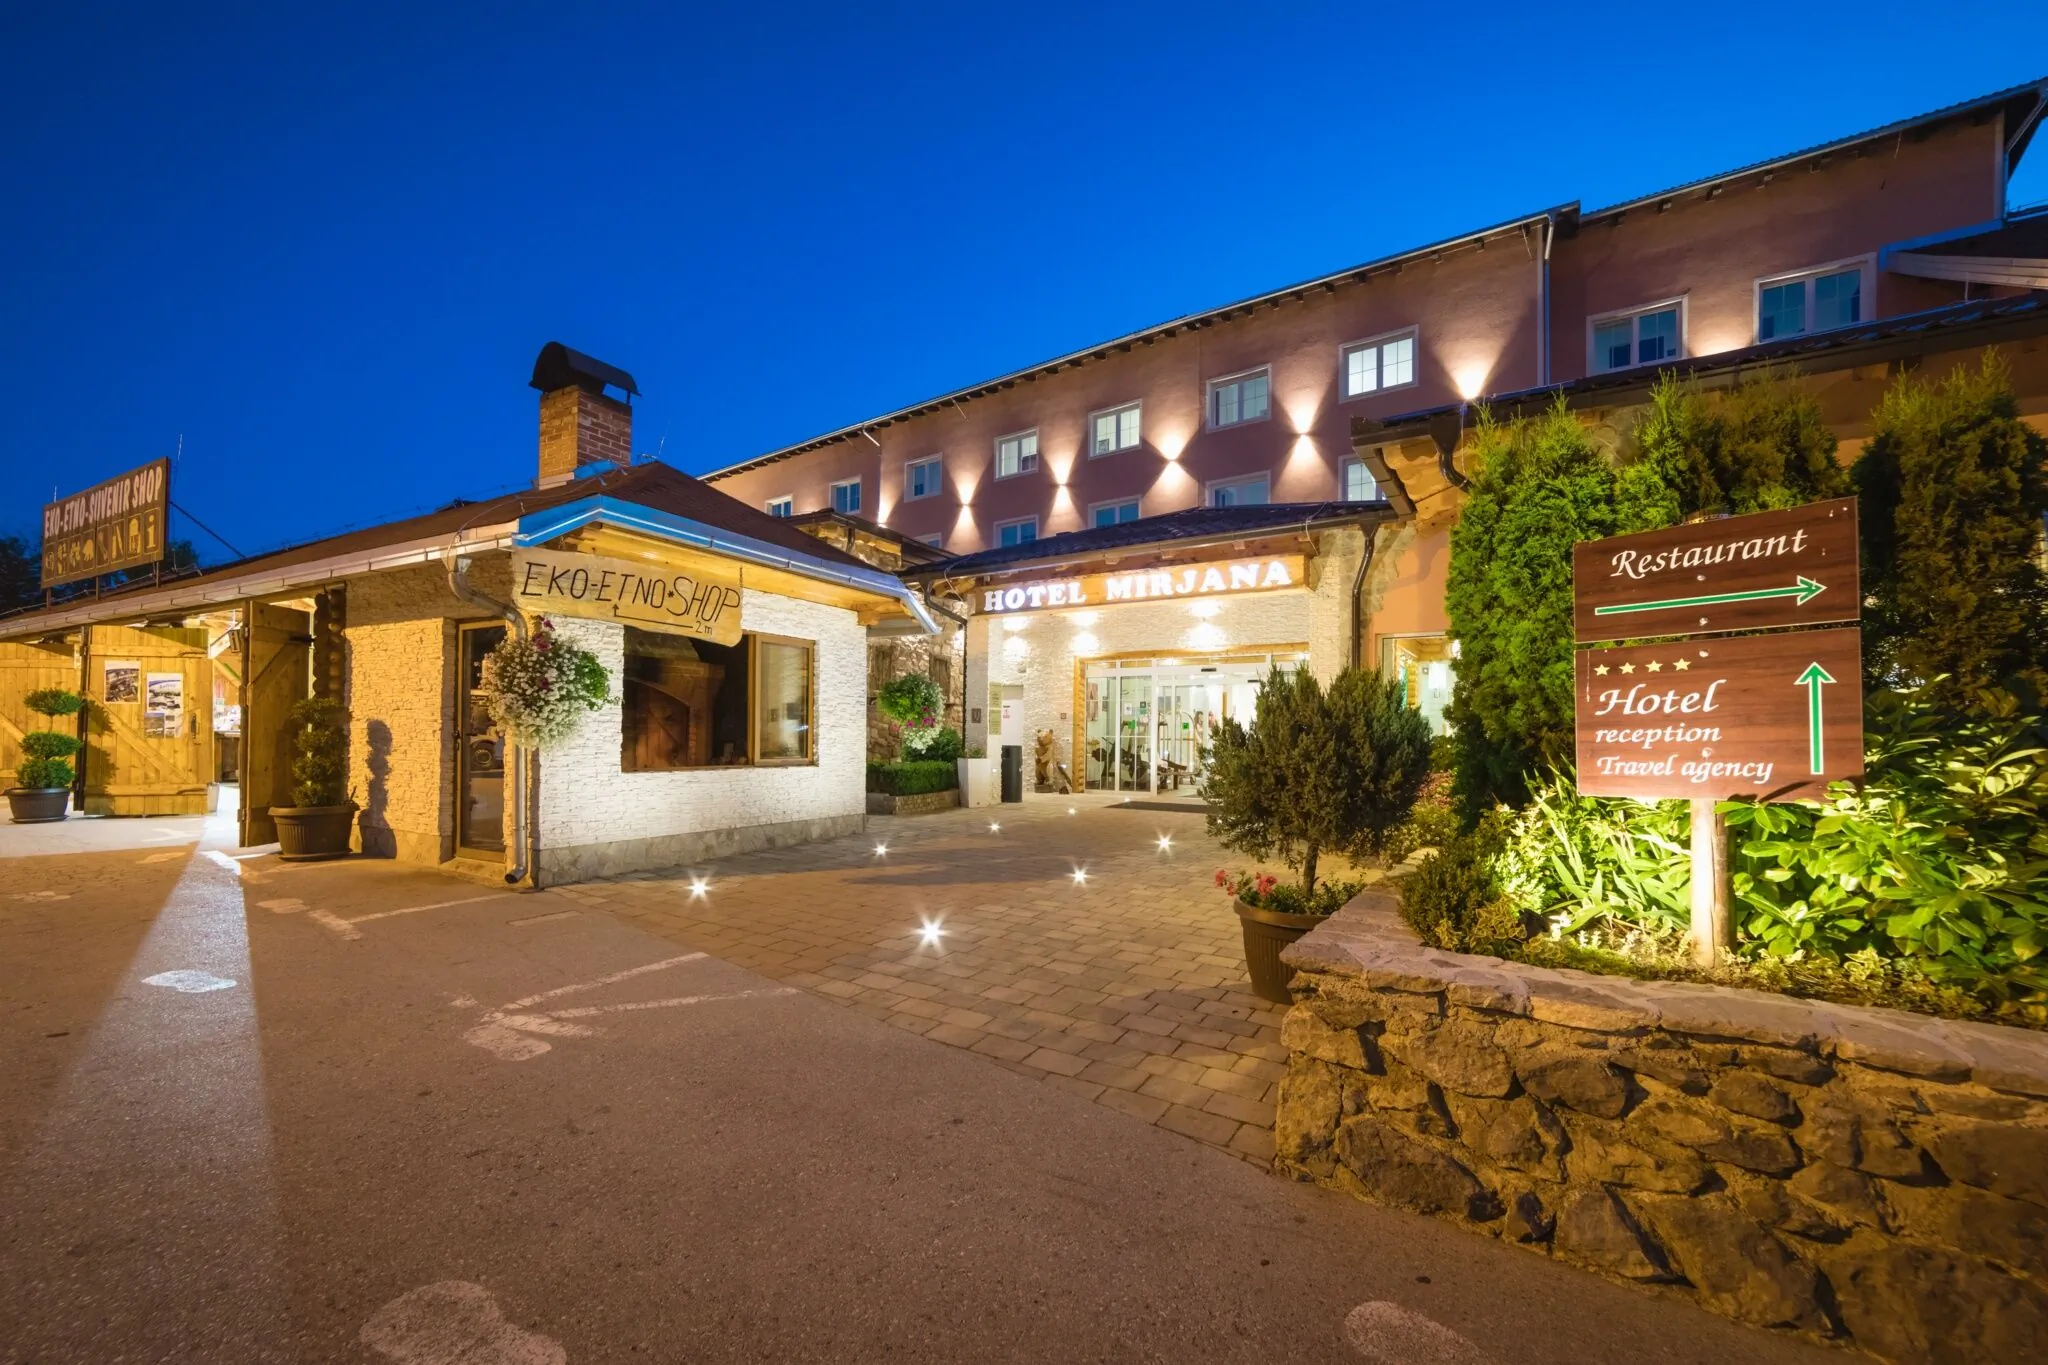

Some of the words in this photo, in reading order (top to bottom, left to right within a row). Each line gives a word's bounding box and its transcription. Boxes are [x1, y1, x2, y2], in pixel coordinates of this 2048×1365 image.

[132, 466, 162, 508] SHOP
[1610, 528, 1808, 580] Restaurant
[984, 582, 1086, 612] HOTEL
[1105, 560, 1292, 601] MIRJANA
[1595, 679, 1727, 716] Hotel
[1595, 722, 1723, 750] reception
[1596, 755, 1680, 777] Travel
[1681, 761, 1774, 784] agency
